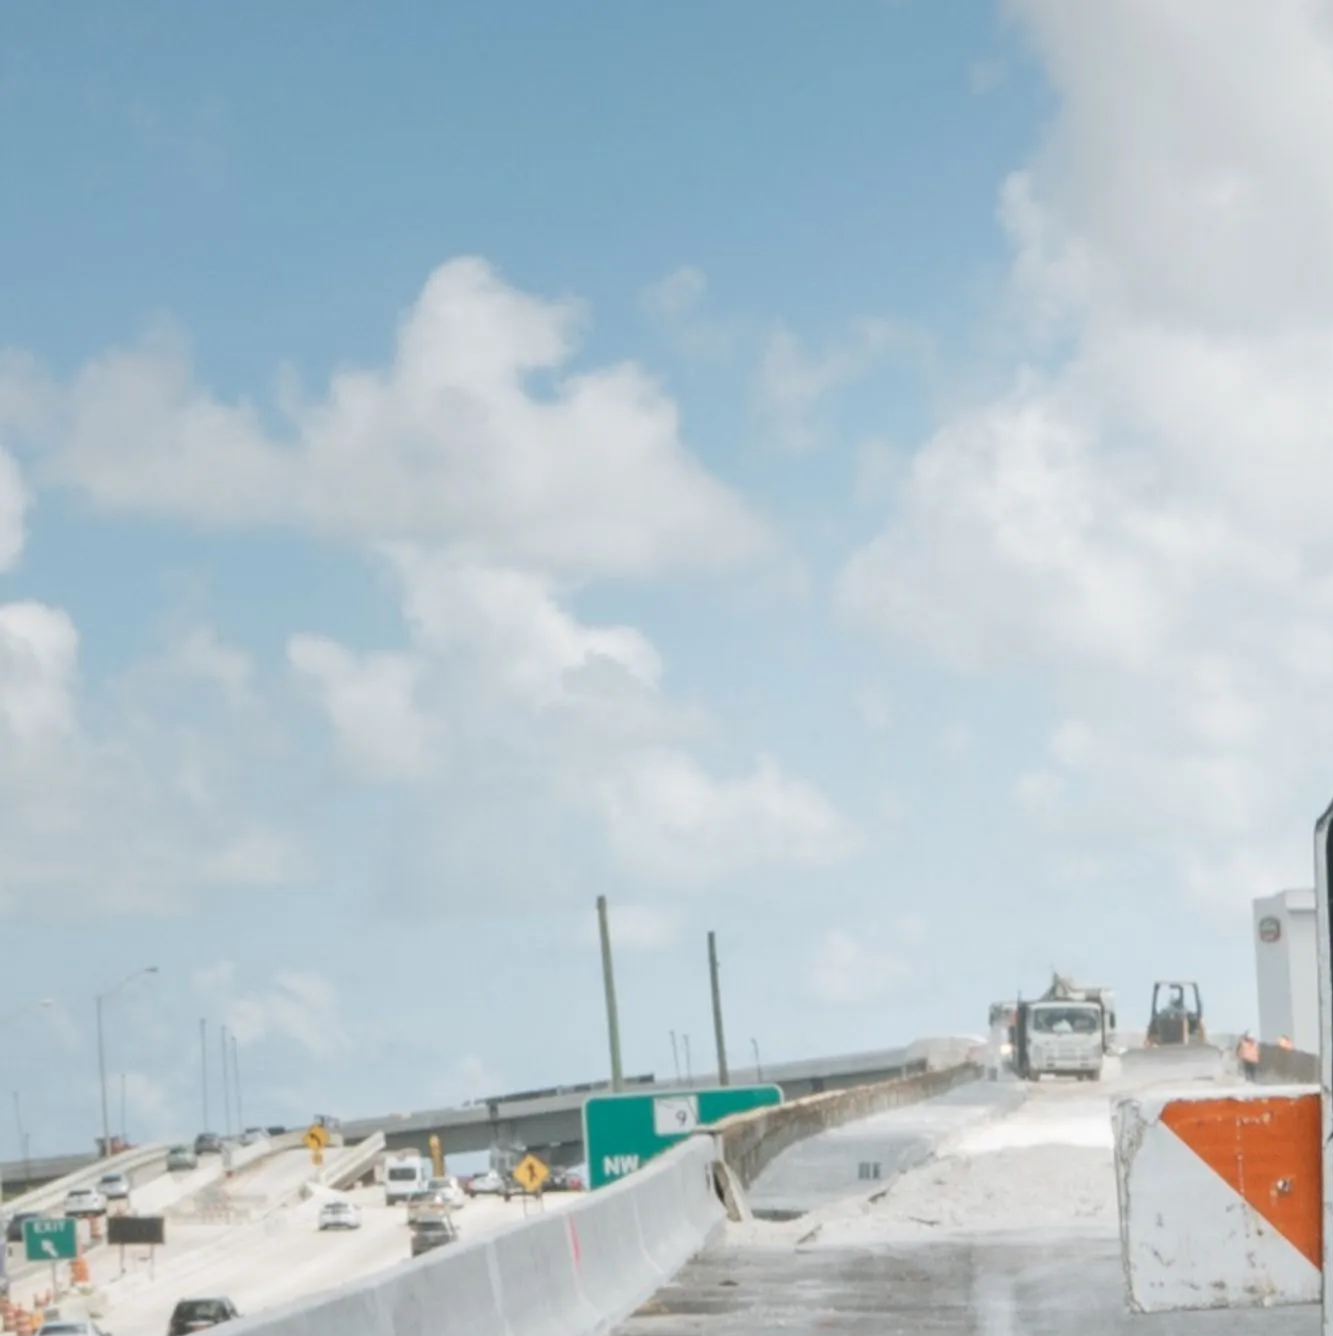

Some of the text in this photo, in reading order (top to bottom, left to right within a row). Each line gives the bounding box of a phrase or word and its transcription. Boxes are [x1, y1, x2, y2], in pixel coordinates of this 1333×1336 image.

[675, 1110, 687, 1127] 9
[603, 1154, 639, 1176] NW
[33, 1220, 66, 1234] EXIT
